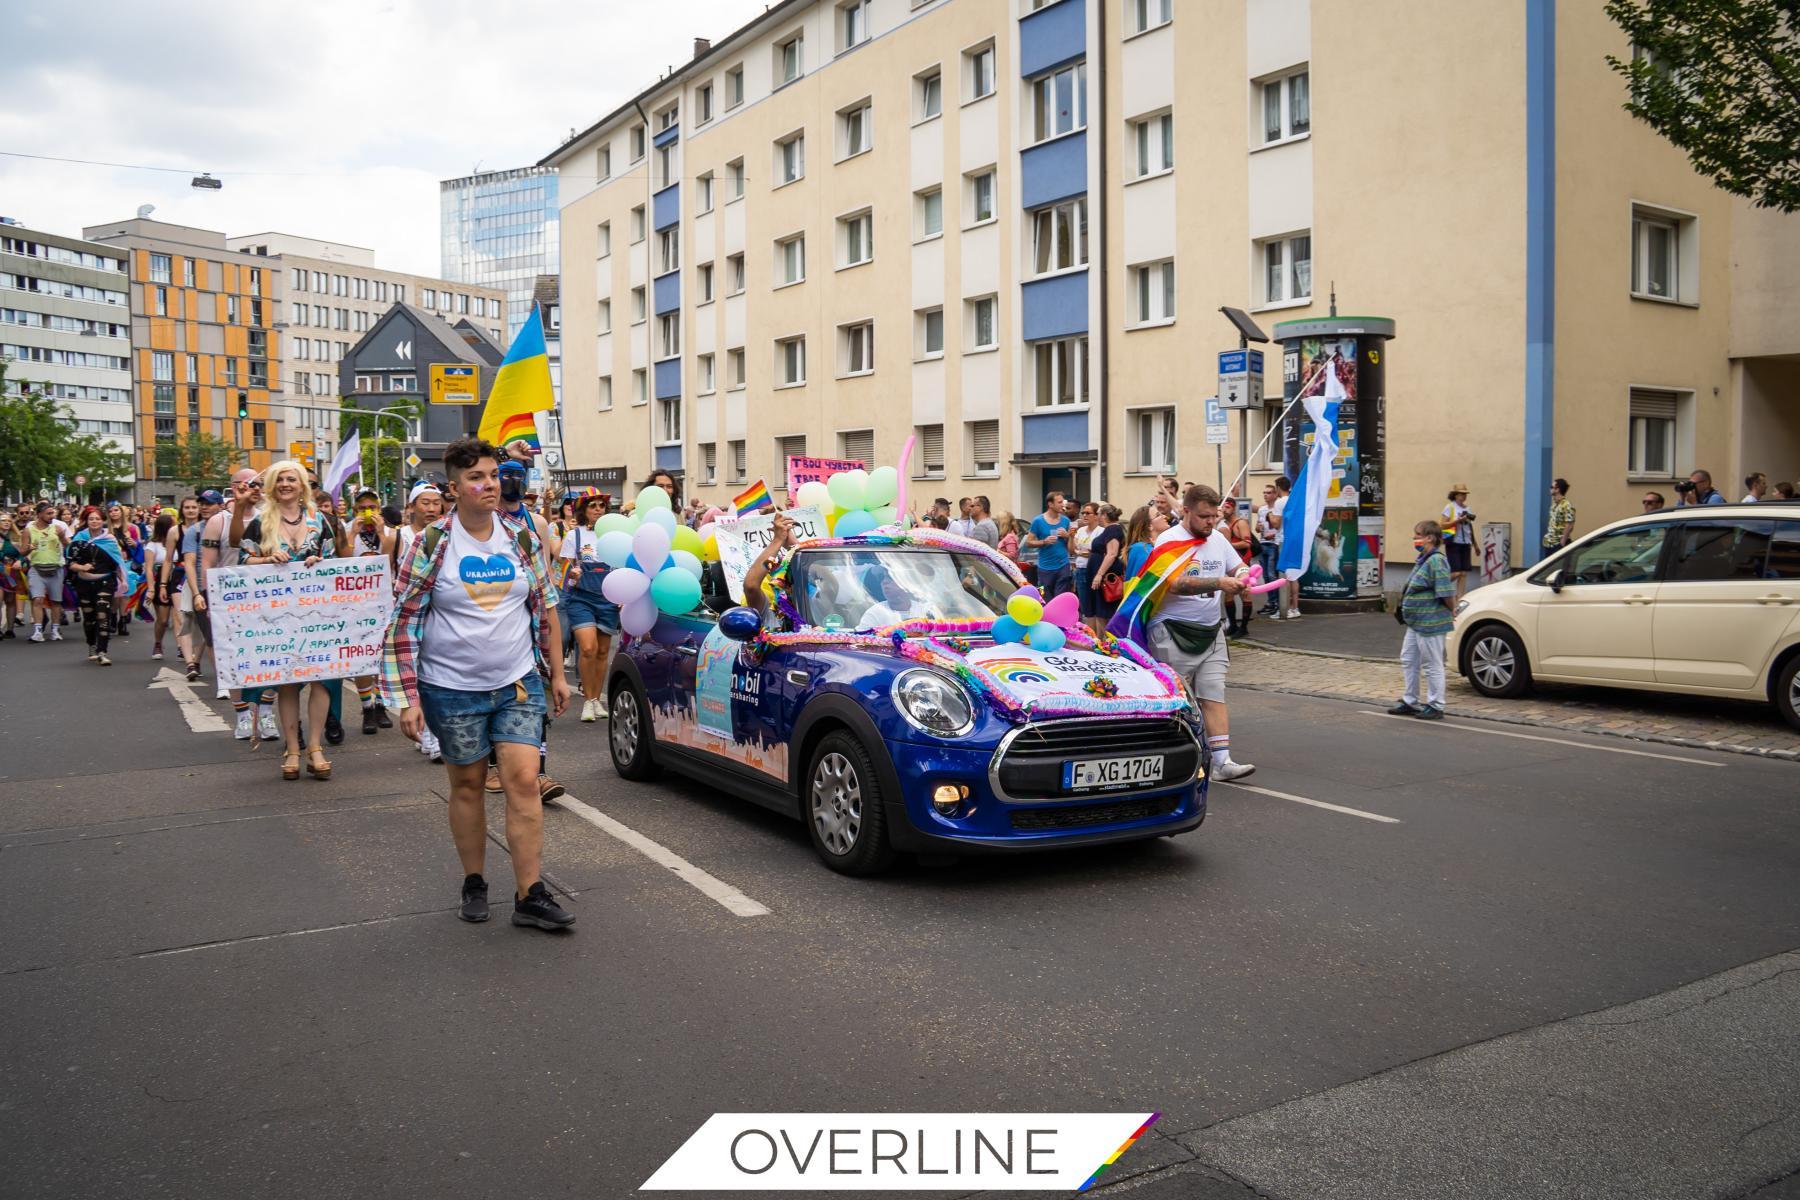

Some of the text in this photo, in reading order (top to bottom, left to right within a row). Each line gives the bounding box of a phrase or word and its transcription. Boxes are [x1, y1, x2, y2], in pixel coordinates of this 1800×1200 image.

[224, 564, 384, 589] NUR WEIL ICH ANDERS BIN
[223, 574, 384, 601] GIBT ES DIR KEIN RECHT
[227, 603, 261, 612] MICH
[235, 618, 376, 638] ТОЛЬКО ПОТОМУ ЧТО
[236, 647, 245, 657] Я
[238, 661, 250, 670] НЕ
[305, 654, 331, 663] ТЕБЕ
[729, 691, 759, 707] arsharing
